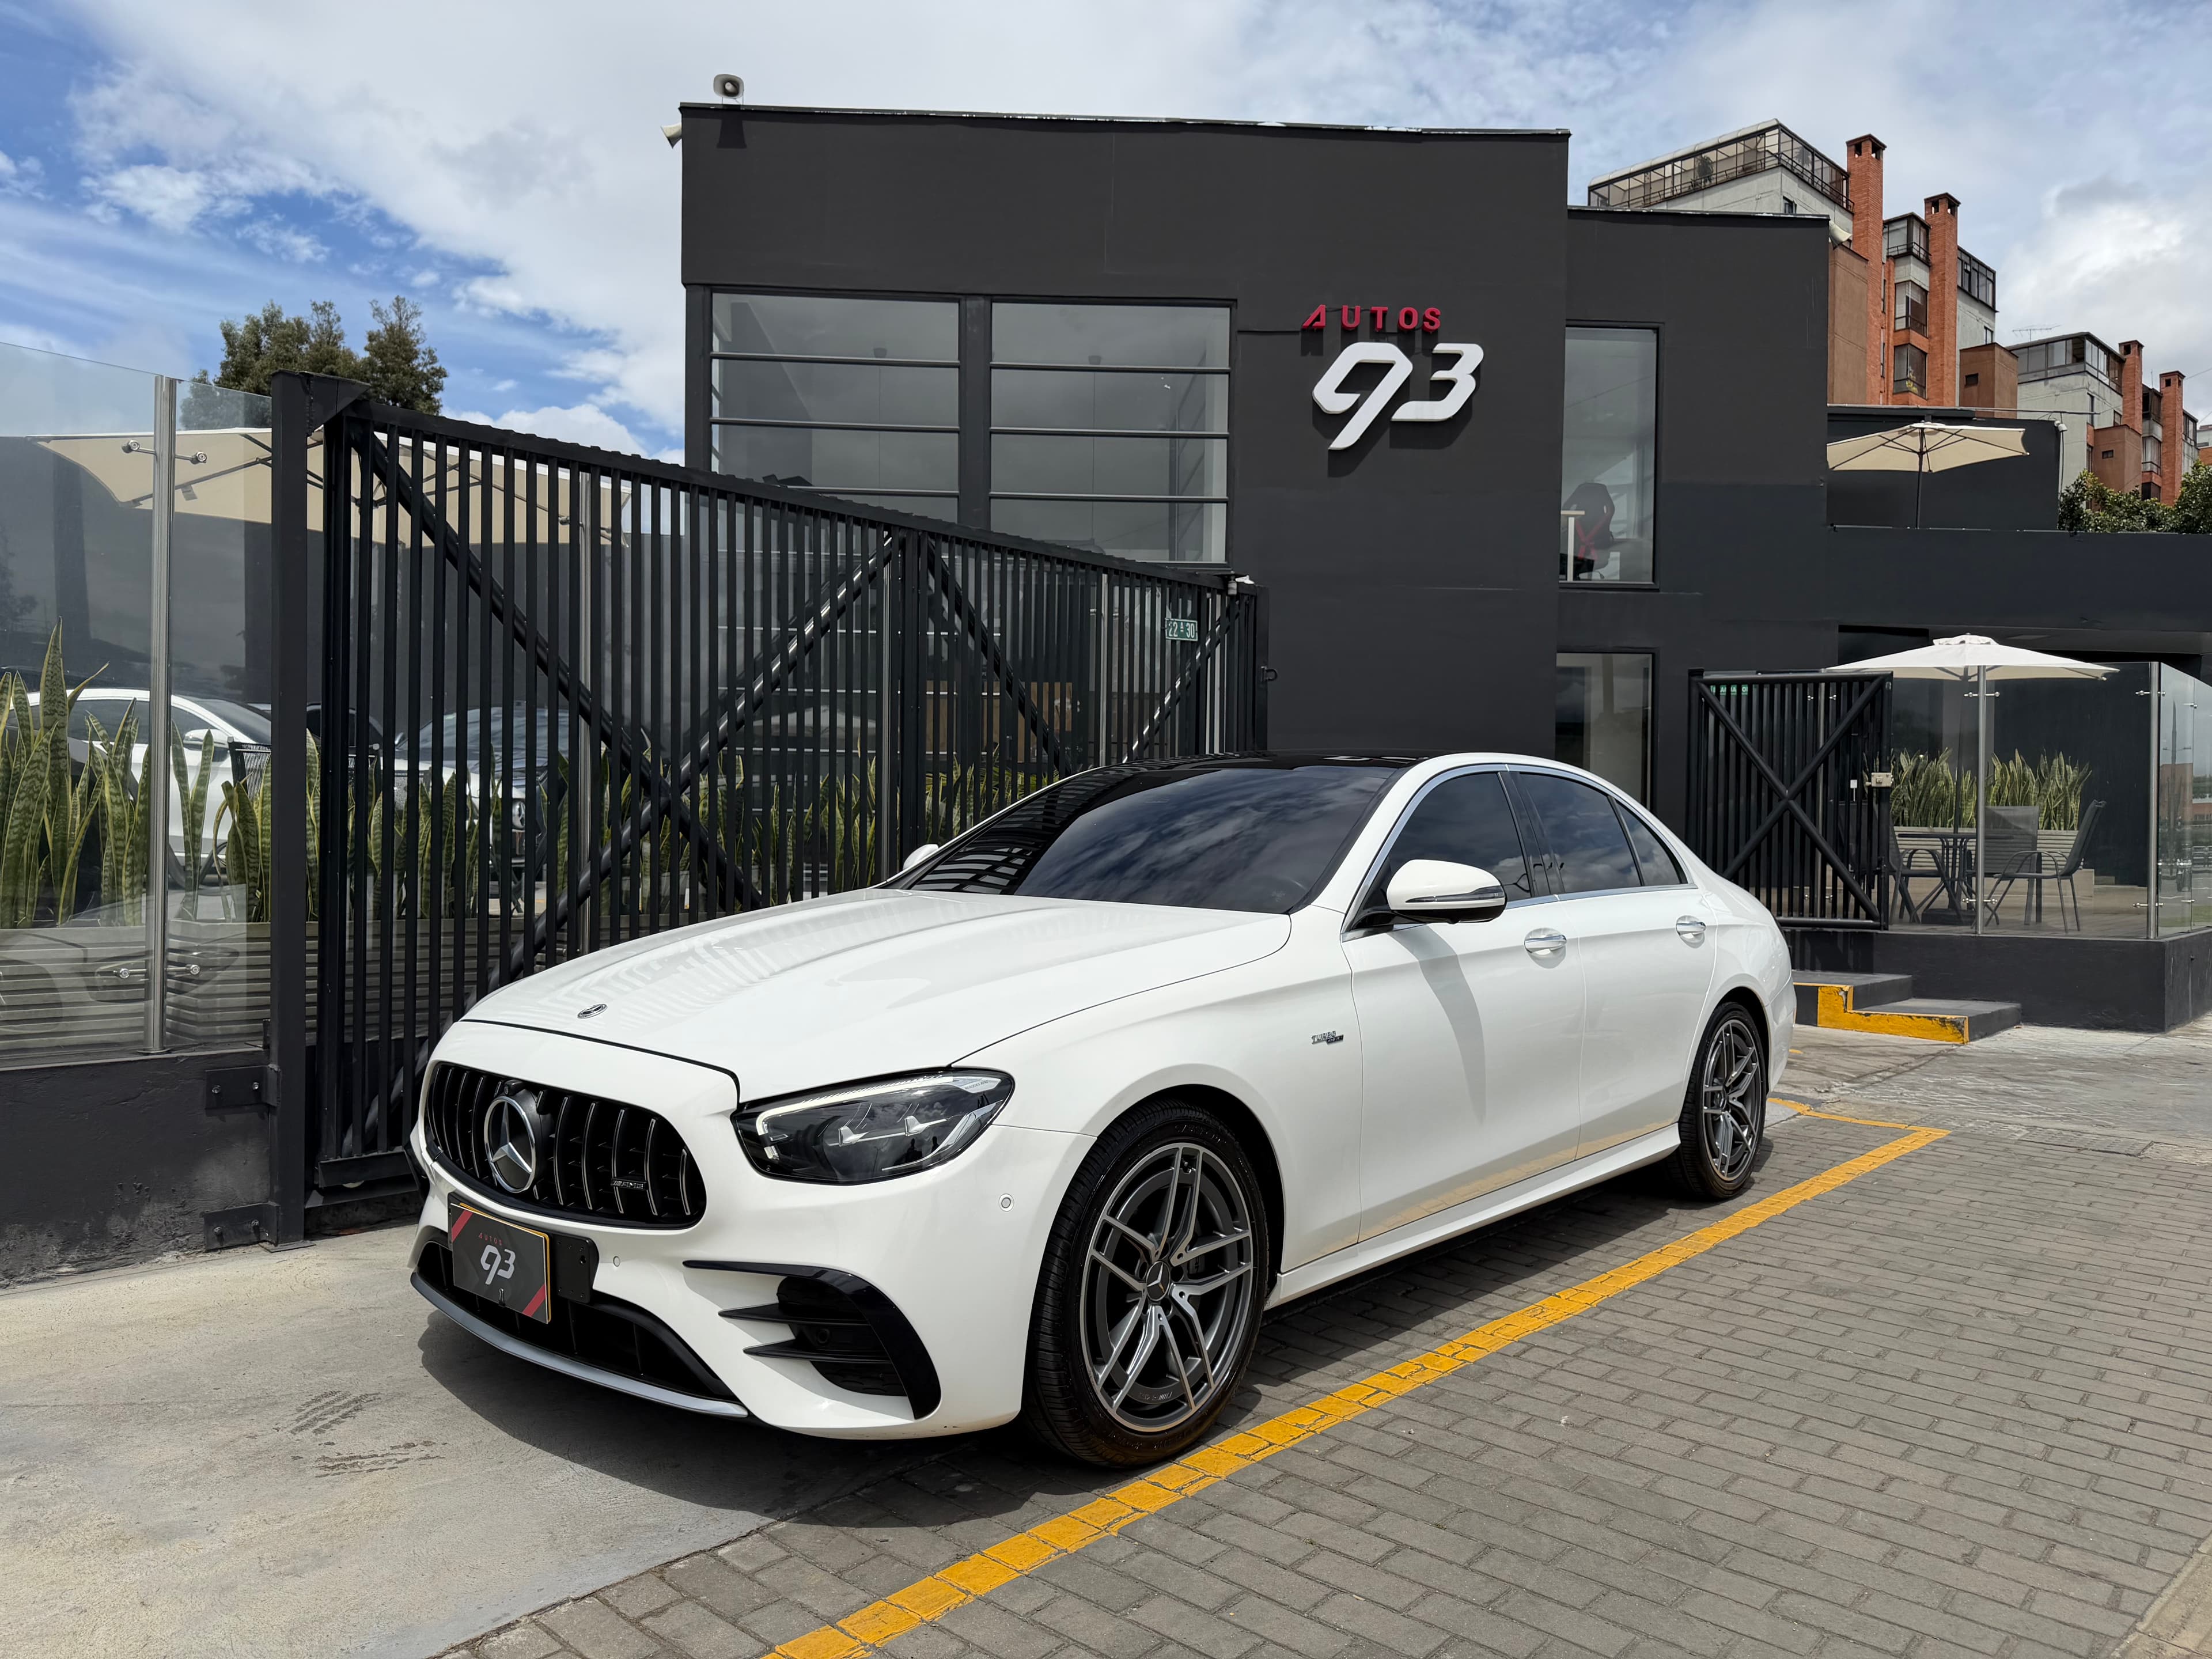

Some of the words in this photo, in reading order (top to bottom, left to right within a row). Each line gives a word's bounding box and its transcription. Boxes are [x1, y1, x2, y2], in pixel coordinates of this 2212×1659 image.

[1301, 304, 1441, 332] AUTOS
[1312, 342, 1484, 450] 93
[1186, 623, 1195, 638] 30
[480, 1244, 516, 1285] 93
